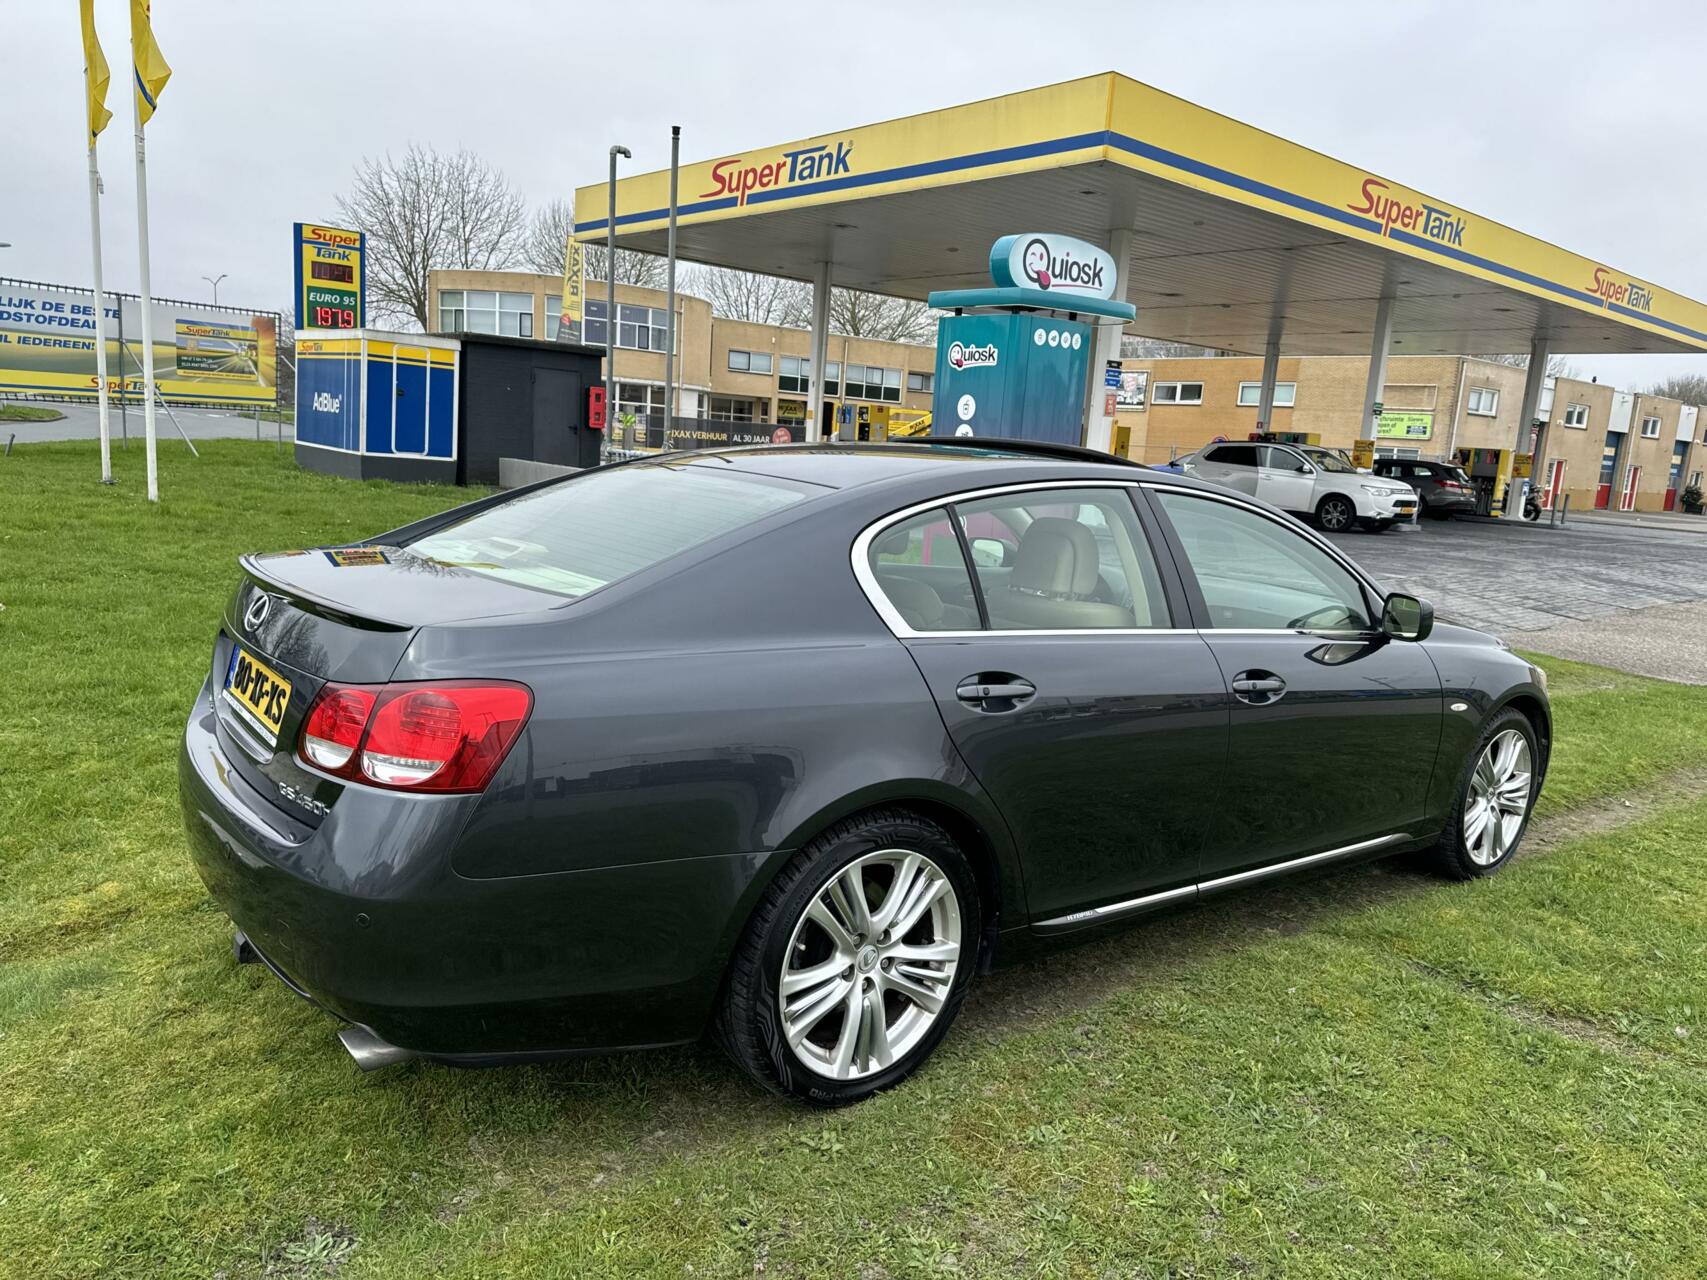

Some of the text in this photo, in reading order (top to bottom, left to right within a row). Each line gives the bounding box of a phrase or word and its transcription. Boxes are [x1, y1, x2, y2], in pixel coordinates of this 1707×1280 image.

[699, 141, 852, 206] SuperTank
[1346, 178, 1467, 247] SuperTank
[303, 228, 359, 247] Super
[312, 246, 351, 261] Tank
[1022, 238, 1104, 291] Quiosk
[309, 292, 356, 305] EURO 95
[1585, 267, 1654, 313] SuperTank
[41, 301, 65, 313] DE
[17, 336, 95, 350] IEDEREEN!
[949, 342, 996, 369] Quiosk
[85, 377, 161, 394] SperTak
[671, 428, 690, 439] IXAX
[692, 430, 728, 442] VERHUUR
[733, 434, 742, 443] AL
[743, 434, 752, 443] 30
[752, 435, 770, 444] JAAR
[234, 656, 287, 725] 80-XF-XS
